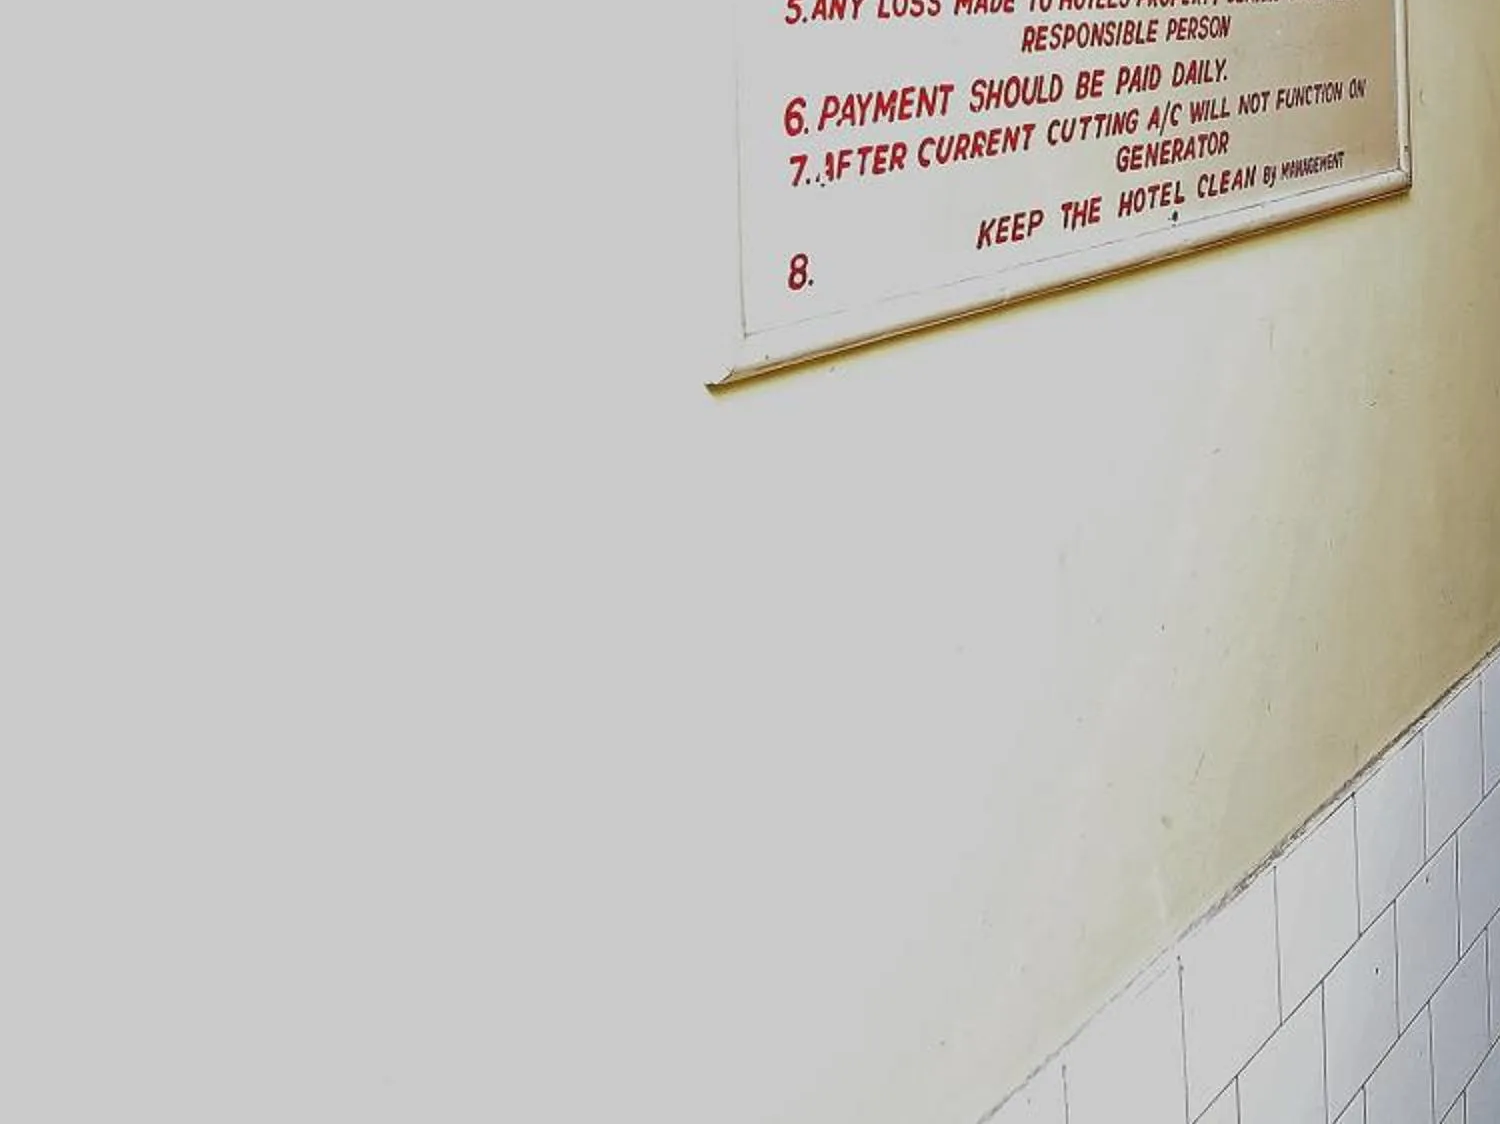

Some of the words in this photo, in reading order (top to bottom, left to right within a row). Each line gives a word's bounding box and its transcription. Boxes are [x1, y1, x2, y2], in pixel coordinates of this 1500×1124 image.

[1021, 19, 1159, 53] RESPONSIBLE
[1166, 15, 1231, 43] PERSON
[817, 84, 955, 131] PAYMENT
[969, 73, 1063, 113] SHOULD
[1075, 69, 1105, 101] BE
[1116, 64, 1161, 95] PAID
[1171, 58, 1228, 88] DAILY.
[917, 123, 1036, 168] CURRENT
[1047, 107, 1139, 147] CUTTING
[1147, 101, 1182, 136] A/C
[1190, 97, 1230, 125] WILL
[1238, 91, 1271, 116] NOT
[1276, 81, 1343, 110] FUNCTION
[1349, 78, 1367, 99] ON
[1117, 130, 1229, 172] GENERATOR
[976, 209, 1045, 250] KEEP
[1061, 196, 1102, 232] THE
[1118, 180, 1185, 218] HOTEL
[1197, 165, 1257, 198] CLEAN
